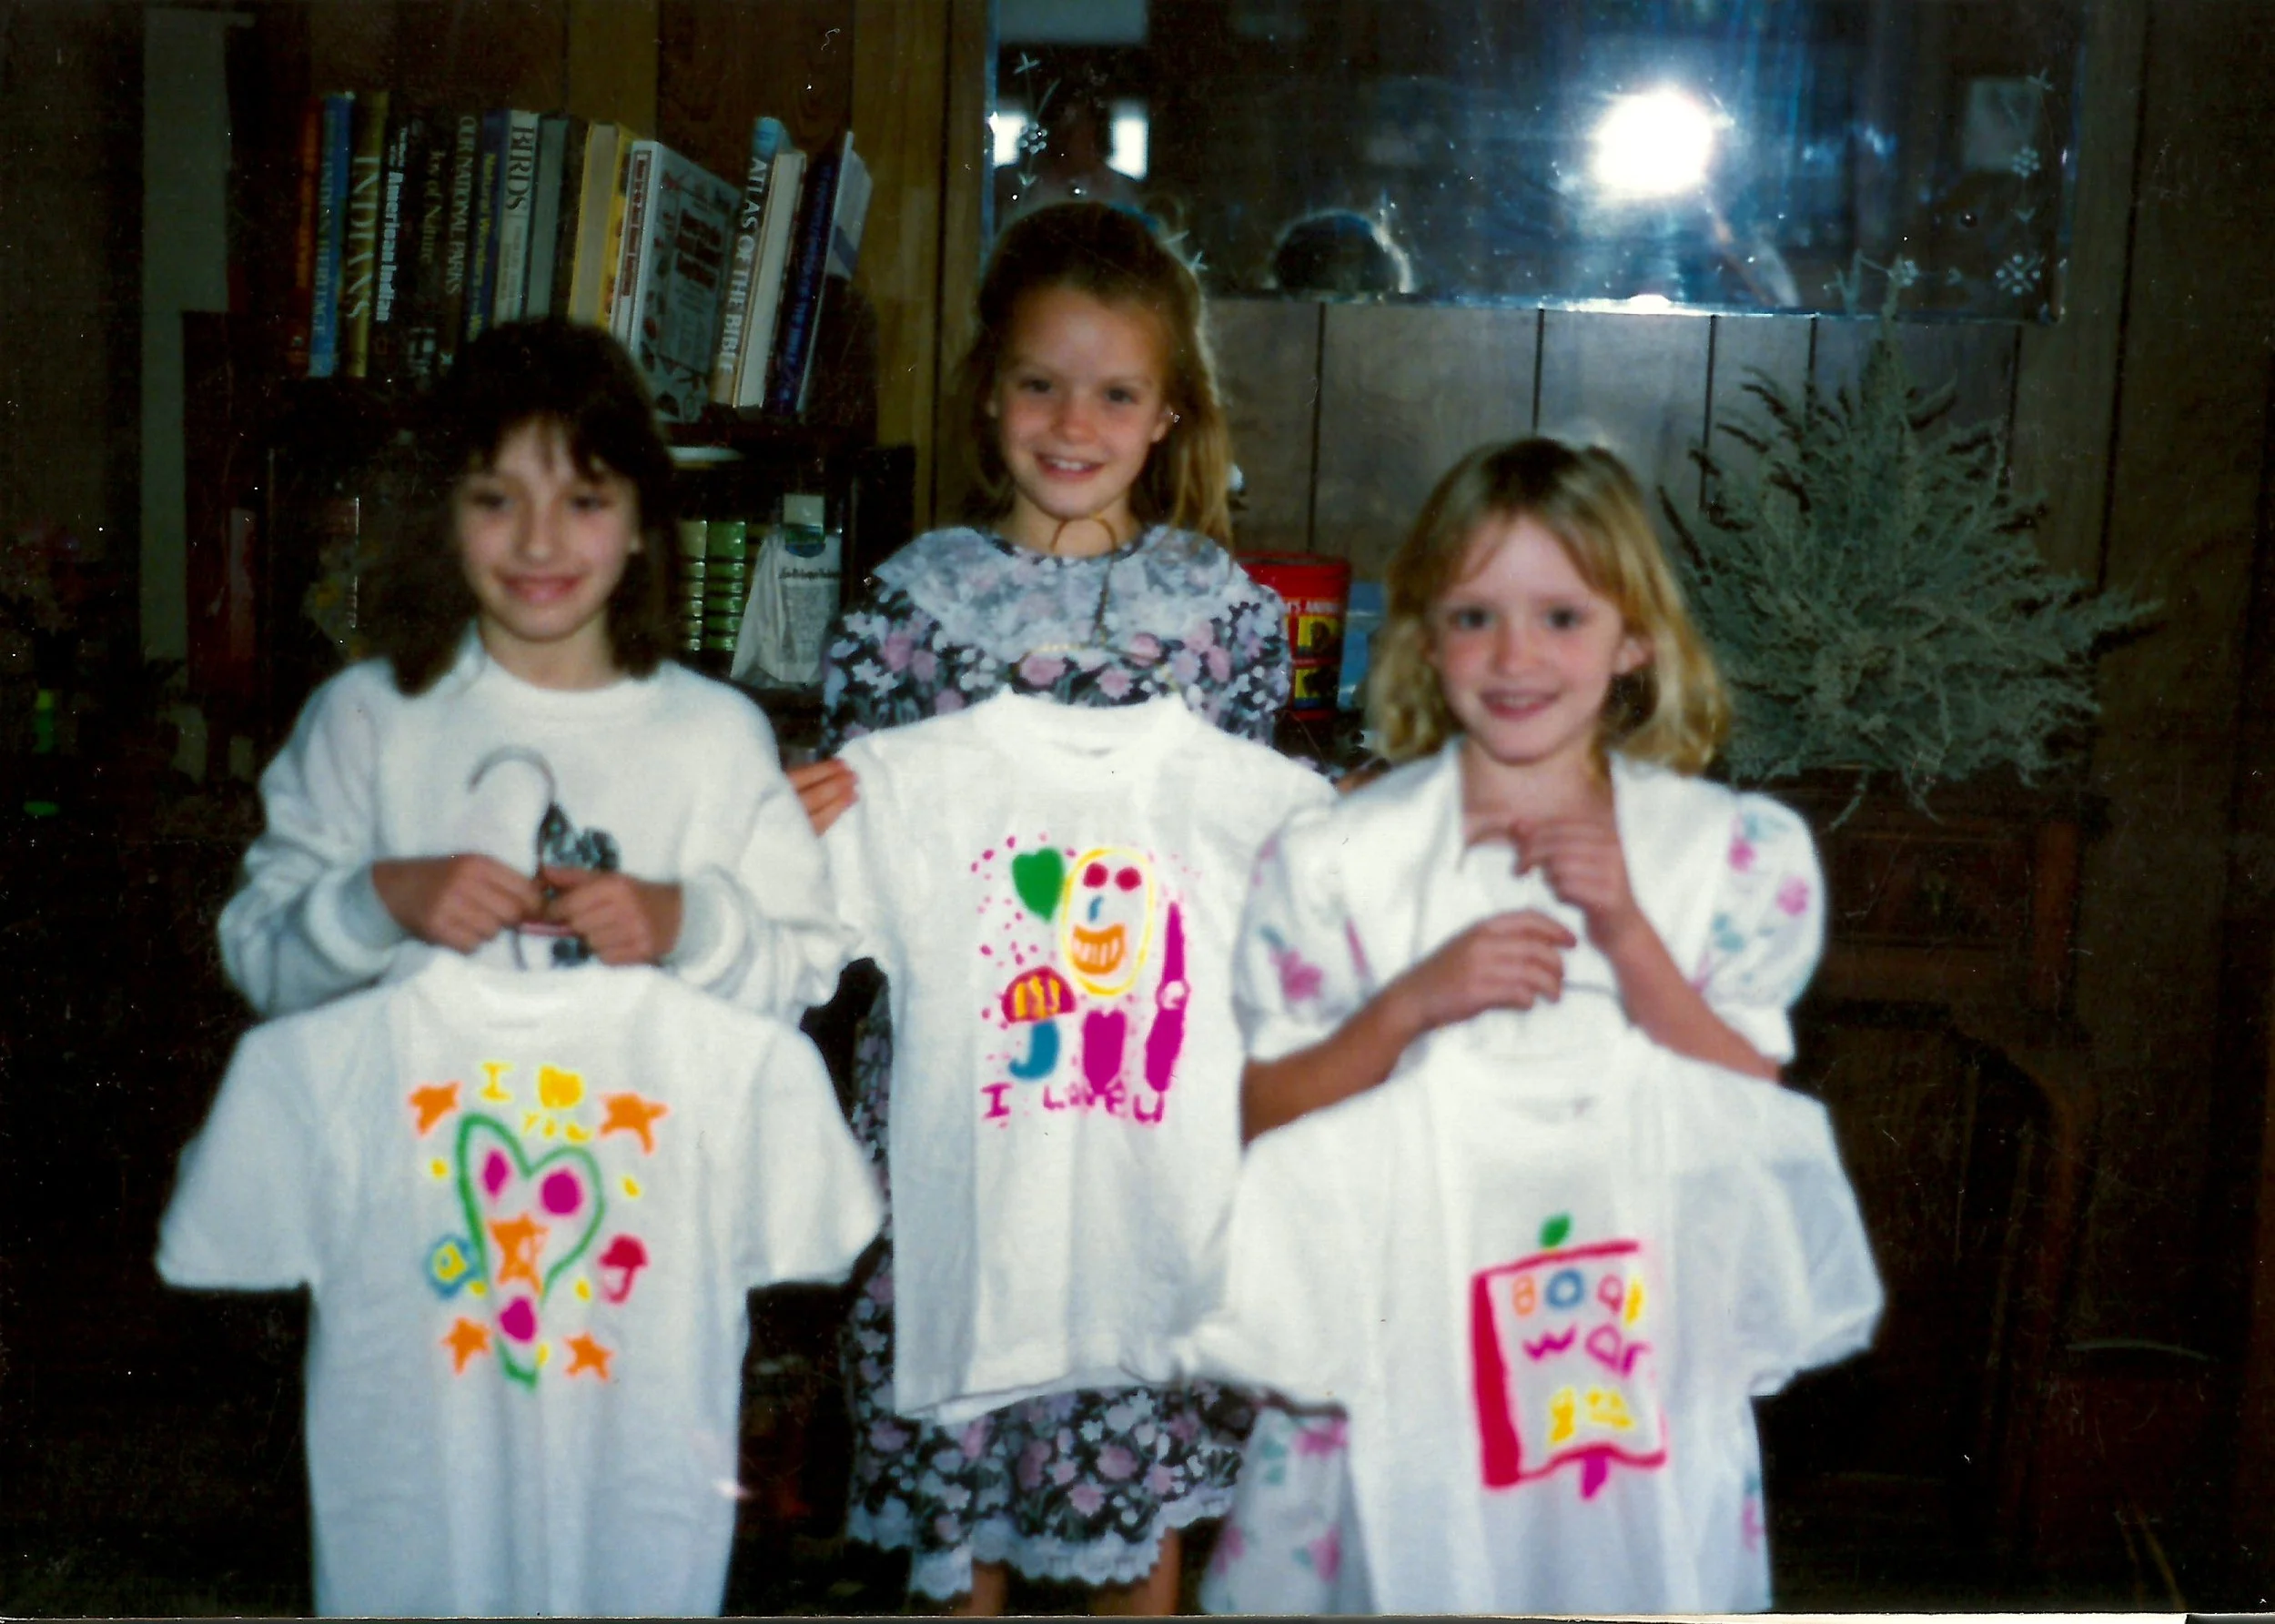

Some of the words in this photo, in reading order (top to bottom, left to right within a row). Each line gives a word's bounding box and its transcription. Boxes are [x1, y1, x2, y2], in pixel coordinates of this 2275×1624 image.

[458, 116, 478, 152] OUR
[449, 155, 474, 237] NATIONAL
[507, 126, 535, 210] BIRDS
[743, 157, 767, 228] ATLAS
[348, 156, 380, 318] INDIANS
[420, 201, 443, 264] Nature
[737, 234, 757, 267] OF
[444, 239, 468, 295] PARKS
[730, 270, 750, 309] THE
[720, 313, 742, 373] BIBLE
[480, 1061, 515, 1103] I
[980, 1081, 1014, 1120] I
